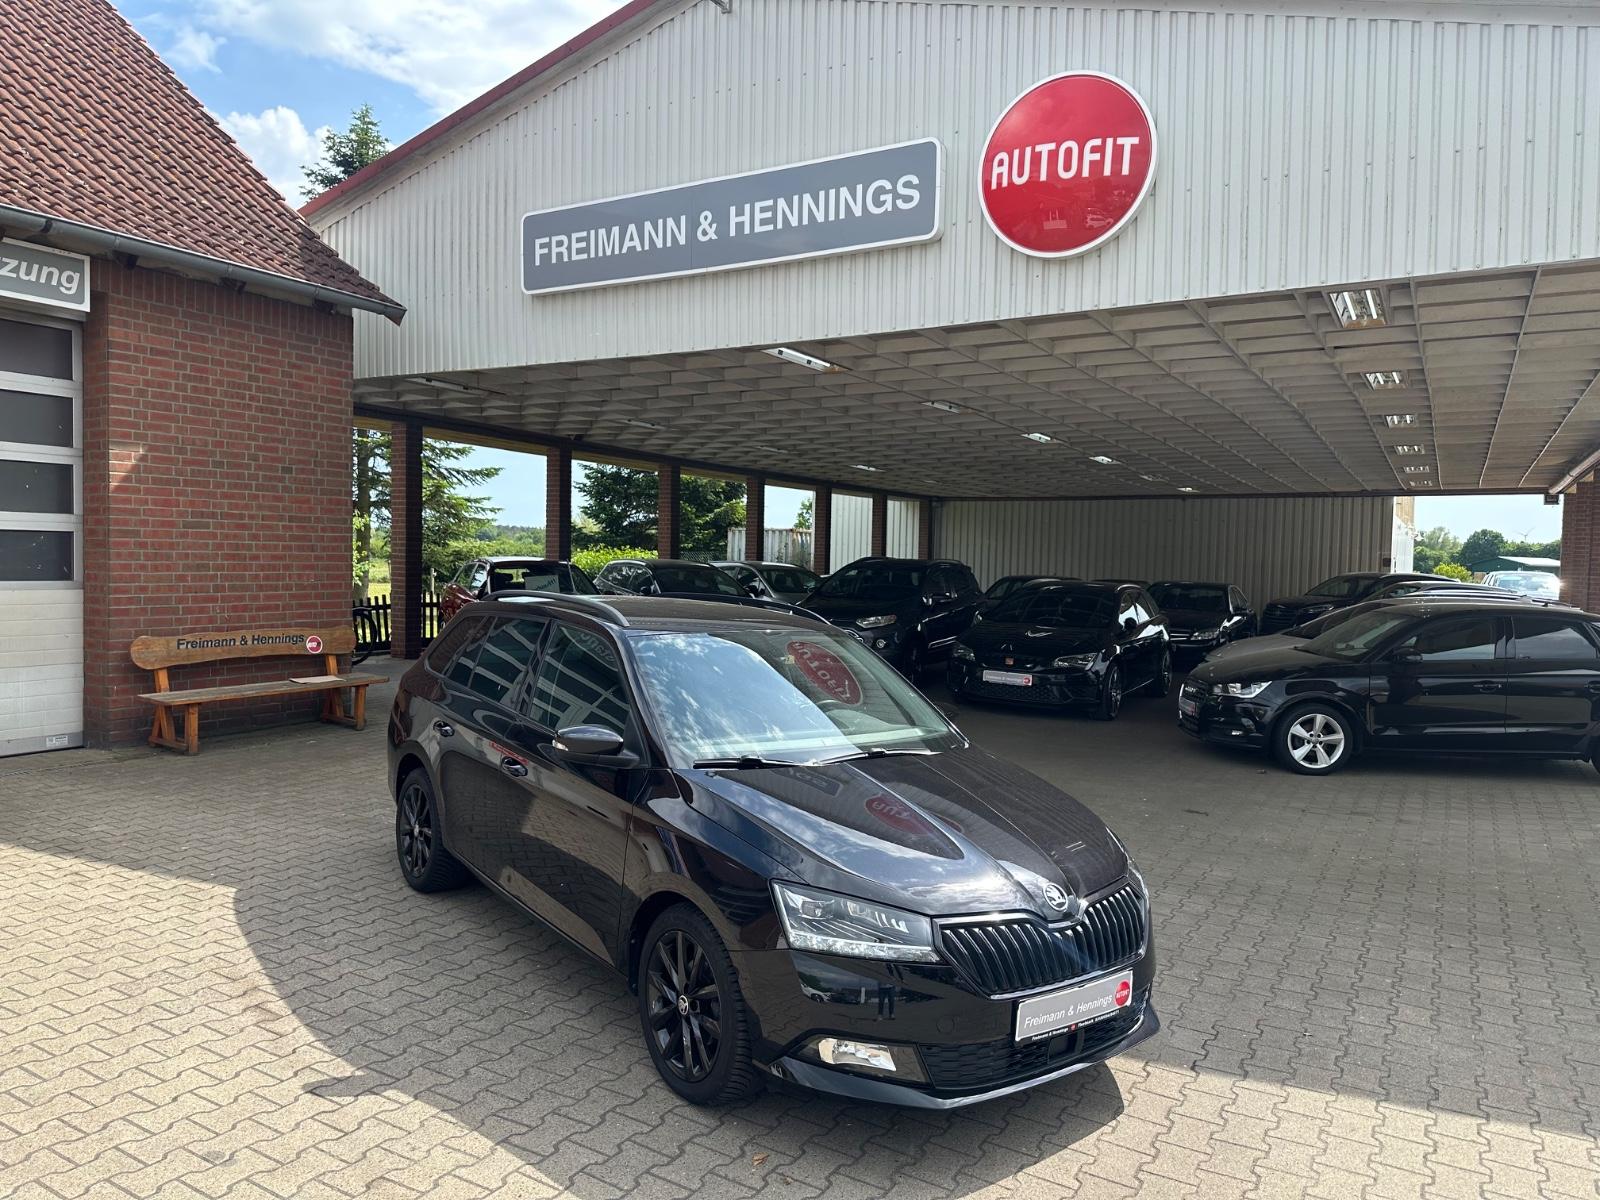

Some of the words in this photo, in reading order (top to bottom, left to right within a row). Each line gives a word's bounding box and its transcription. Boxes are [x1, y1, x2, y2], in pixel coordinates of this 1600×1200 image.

[991, 136, 1140, 190] AUTOFIT
[534, 215, 687, 266] FREIMANN
[696, 207, 718, 241] &
[729, 173, 921, 238] HENNINGS
[0, 257, 80, 295] zung
[177, 638, 236, 650] Freimann
[240, 635, 248, 646] &
[252, 633, 305, 645] Hennings
[1024, 1010, 1065, 1029] Freimann
[1067, 1005, 1075, 1016] &
[1076, 994, 1113, 1014] Hennings
